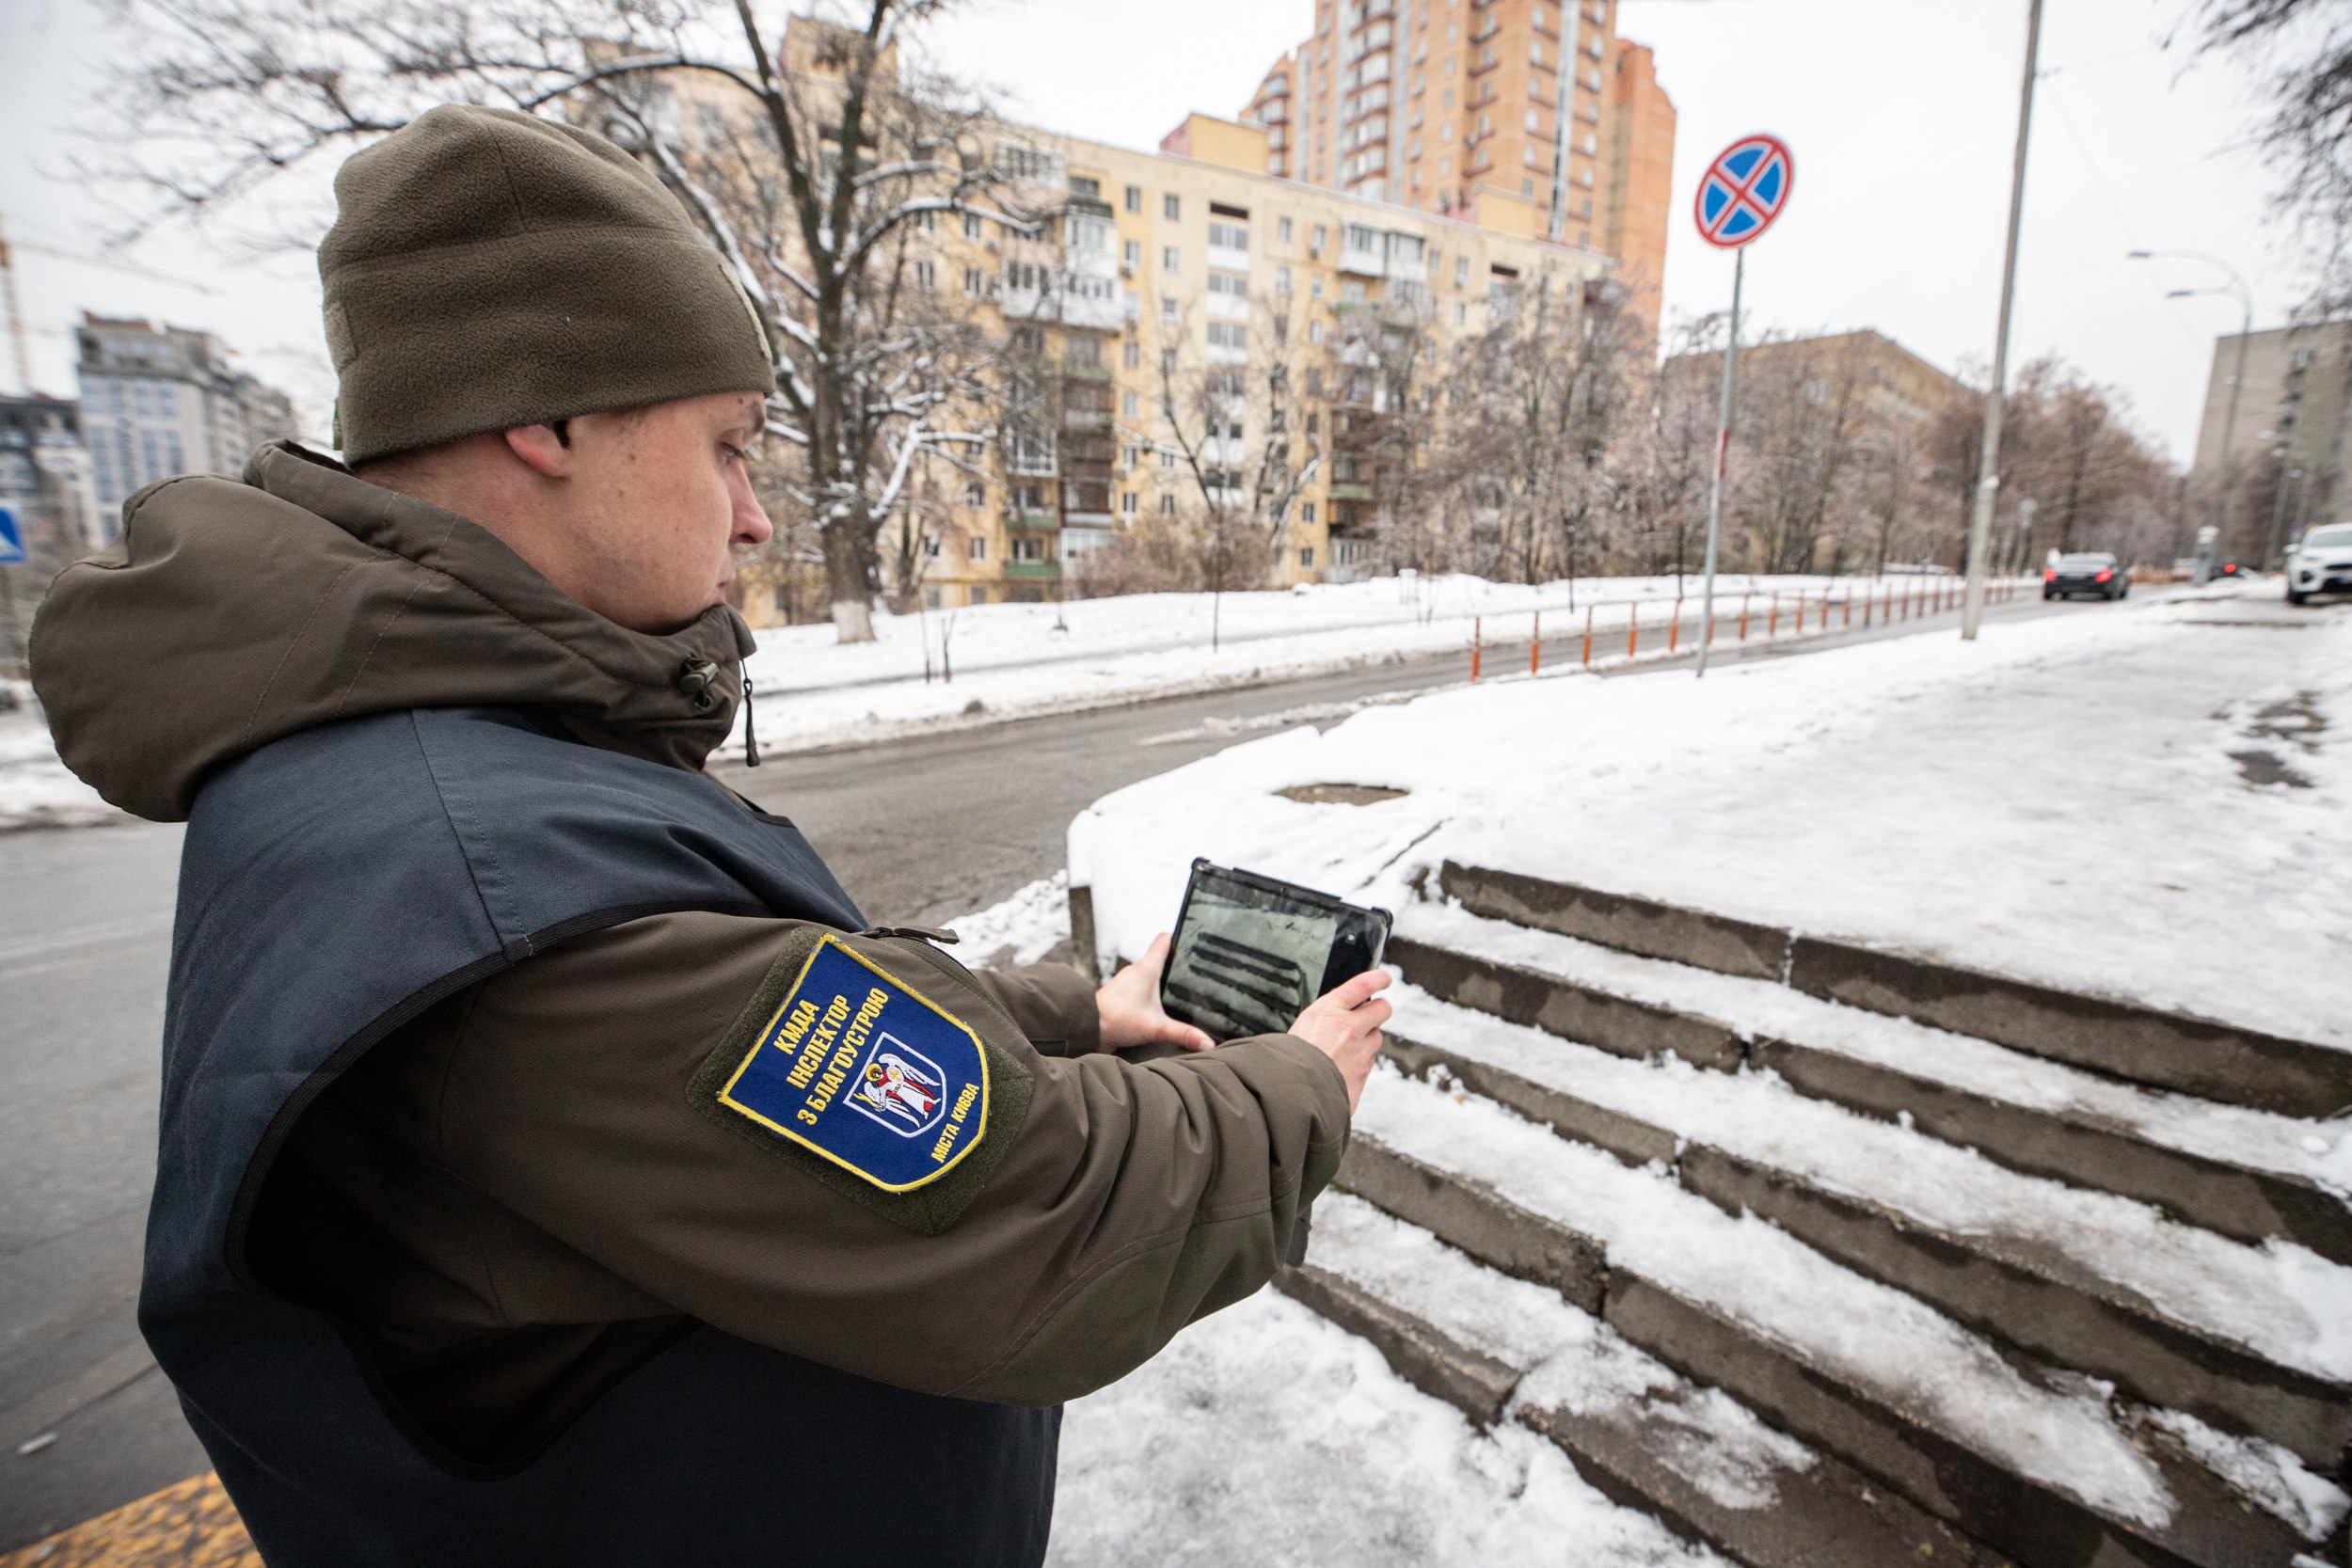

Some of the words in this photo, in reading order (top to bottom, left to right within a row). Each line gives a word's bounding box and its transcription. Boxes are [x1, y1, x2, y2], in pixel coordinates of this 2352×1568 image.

[773, 1000, 819, 1055] КМДА
[786, 994, 851, 1089] ІНСПЕКТОР
[797, 1109, 817, 1126] З
[810, 988, 889, 1113] БЛАГОУСТРОЮ
[930, 1123, 960, 1164] МІСТА
[950, 1083, 979, 1123] КИЄВА
